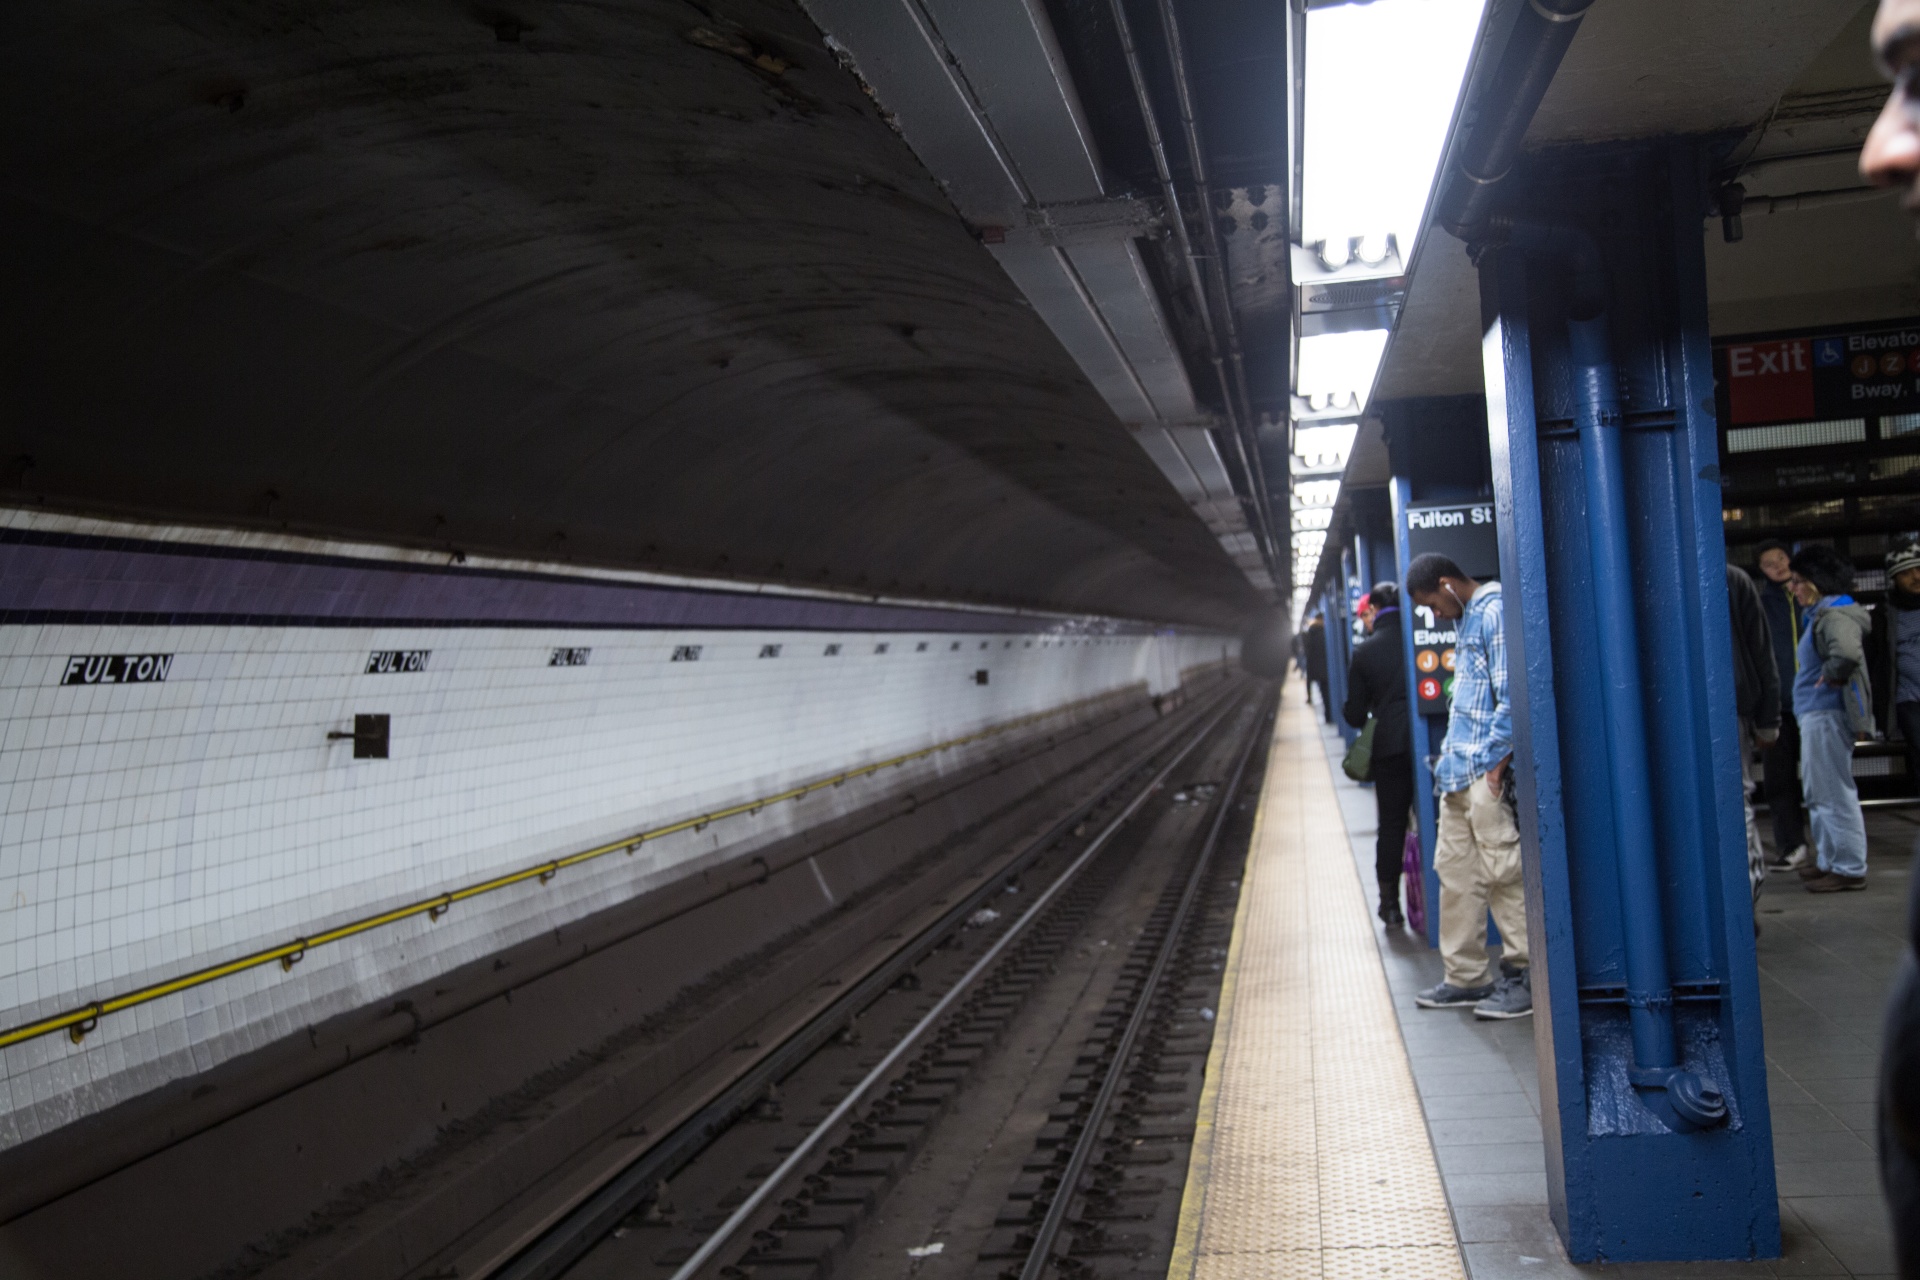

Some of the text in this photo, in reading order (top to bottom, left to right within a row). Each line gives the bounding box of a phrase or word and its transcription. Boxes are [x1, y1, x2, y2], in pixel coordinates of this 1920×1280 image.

[1848, 331, 1920, 351] Elevato
[1729, 341, 1807, 378] Exit
[1858, 360, 1869, 374] J
[1887, 357, 1899, 372] Z
[1408, 506, 1492, 530] Fulton St
[1414, 629, 1456, 646] Eleva
[62, 655, 172, 685] FULTON
[365, 651, 432, 674] FULTON
[1422, 653, 1433, 669] J
[1424, 681, 1436, 697] 3
